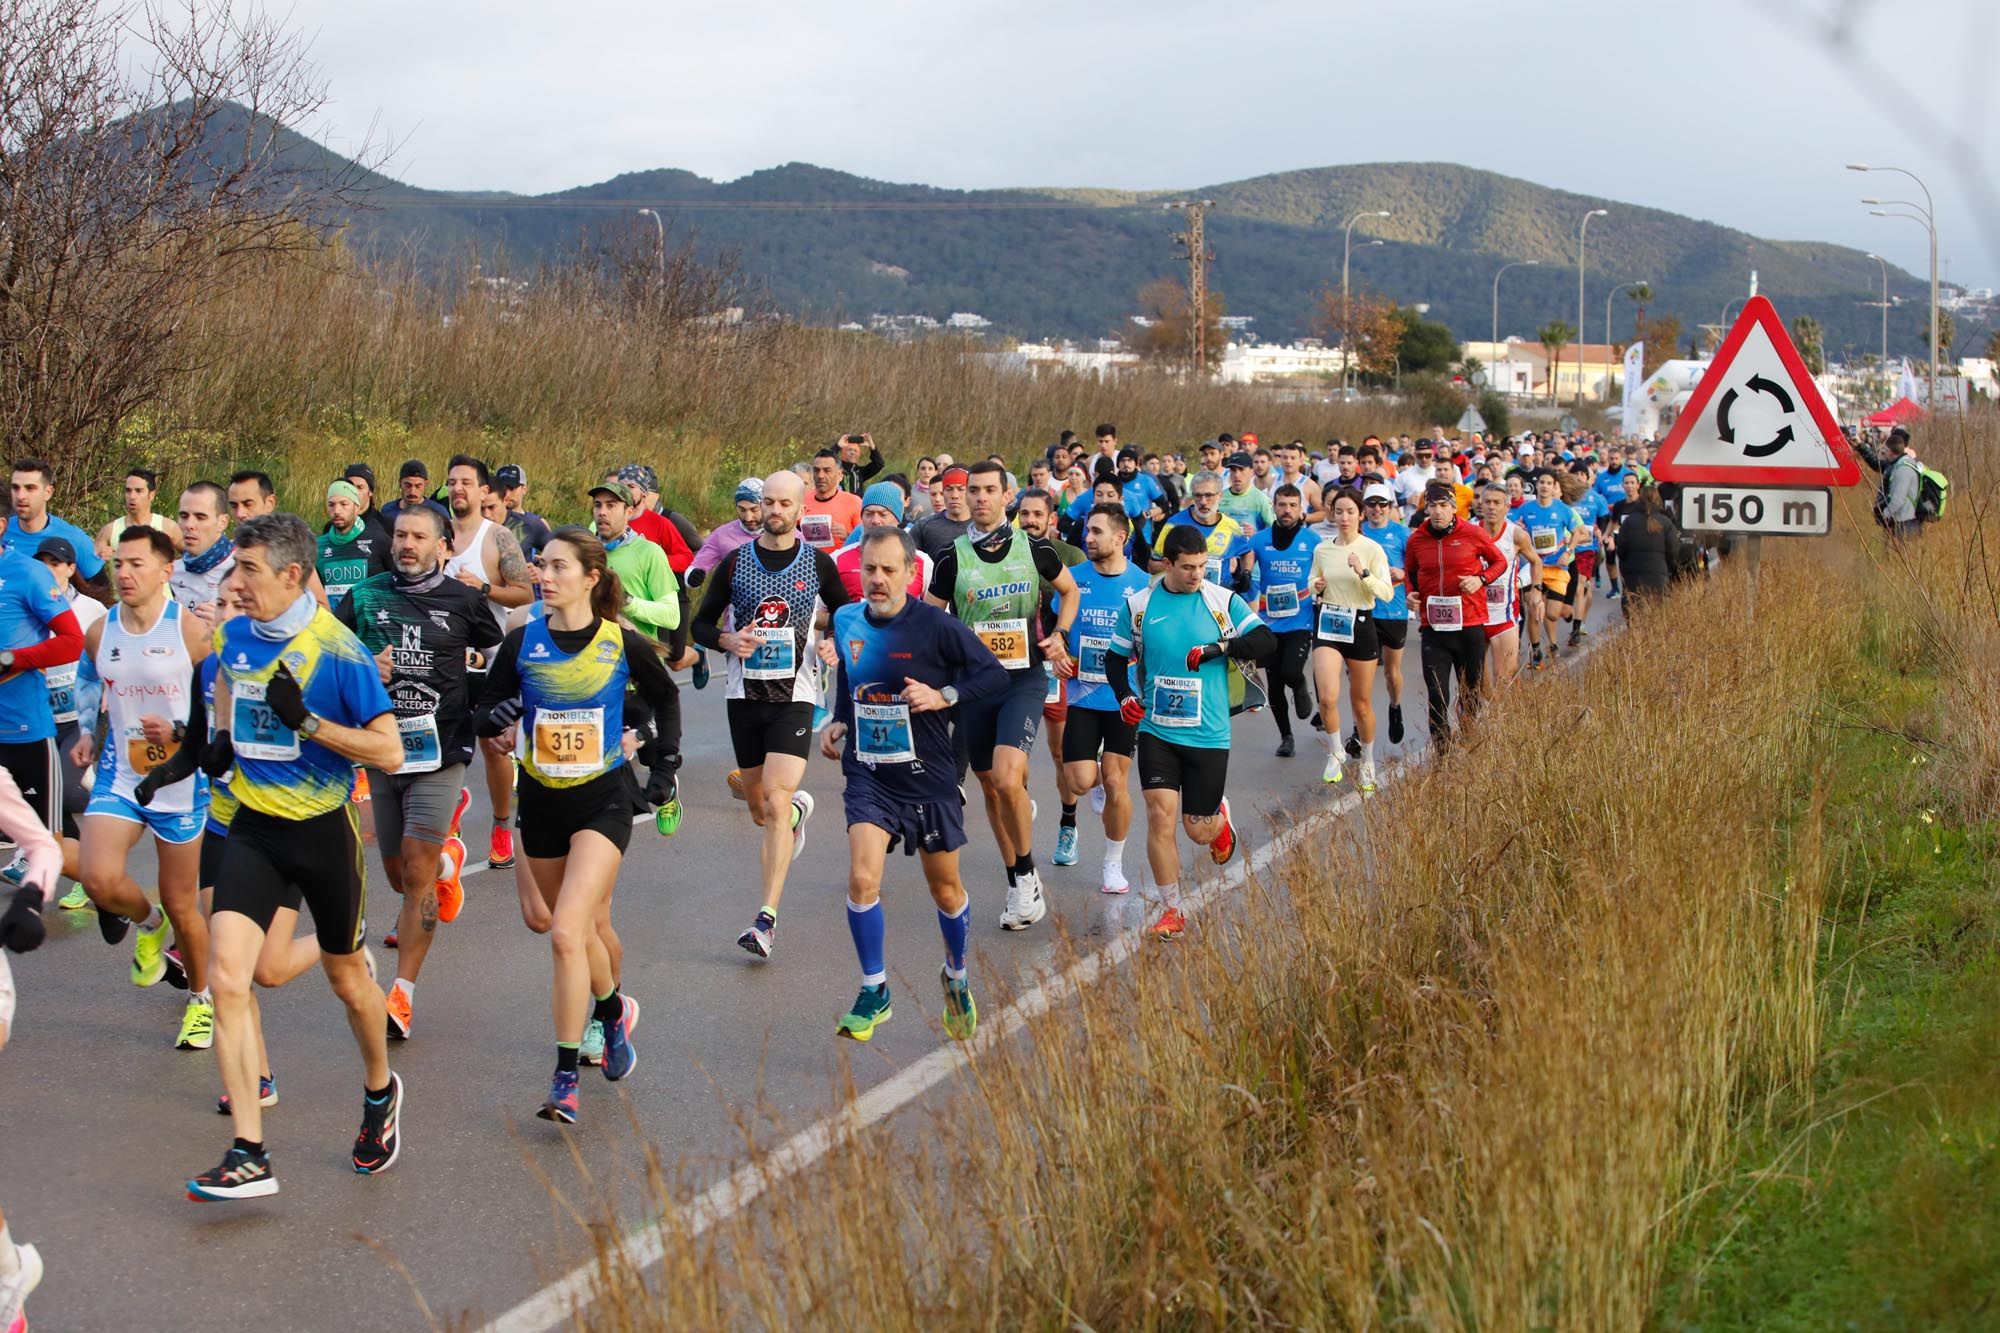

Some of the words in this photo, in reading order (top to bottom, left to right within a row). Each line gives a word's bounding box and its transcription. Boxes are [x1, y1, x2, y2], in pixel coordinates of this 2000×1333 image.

[1693, 493, 1764, 525] 150
[1783, 501, 1816, 526] m
[811, 526, 821, 536] 46
[977, 582, 1030, 601] SALTOKI
[1486, 588, 1497, 598] 01
[1081, 608, 1119, 620] VUELA
[1436, 608, 1454, 618] 302
[1092, 617, 1118, 627] IBIZ
[1330, 618, 1345, 629] 164
[991, 637, 1016, 652] 582
[758, 646, 780, 660] 121
[396, 689, 423, 700] VILLA
[1168, 694, 1184, 709] 22
[393, 699, 433, 711] ERCEDES
[249, 707, 280, 731] 325
[398, 718, 429, 730] KIBIZA
[872, 725, 889, 742] 41
[403, 735, 425, 751] 98
[551, 731, 585, 751] 315
[146, 744, 167, 762] 68
